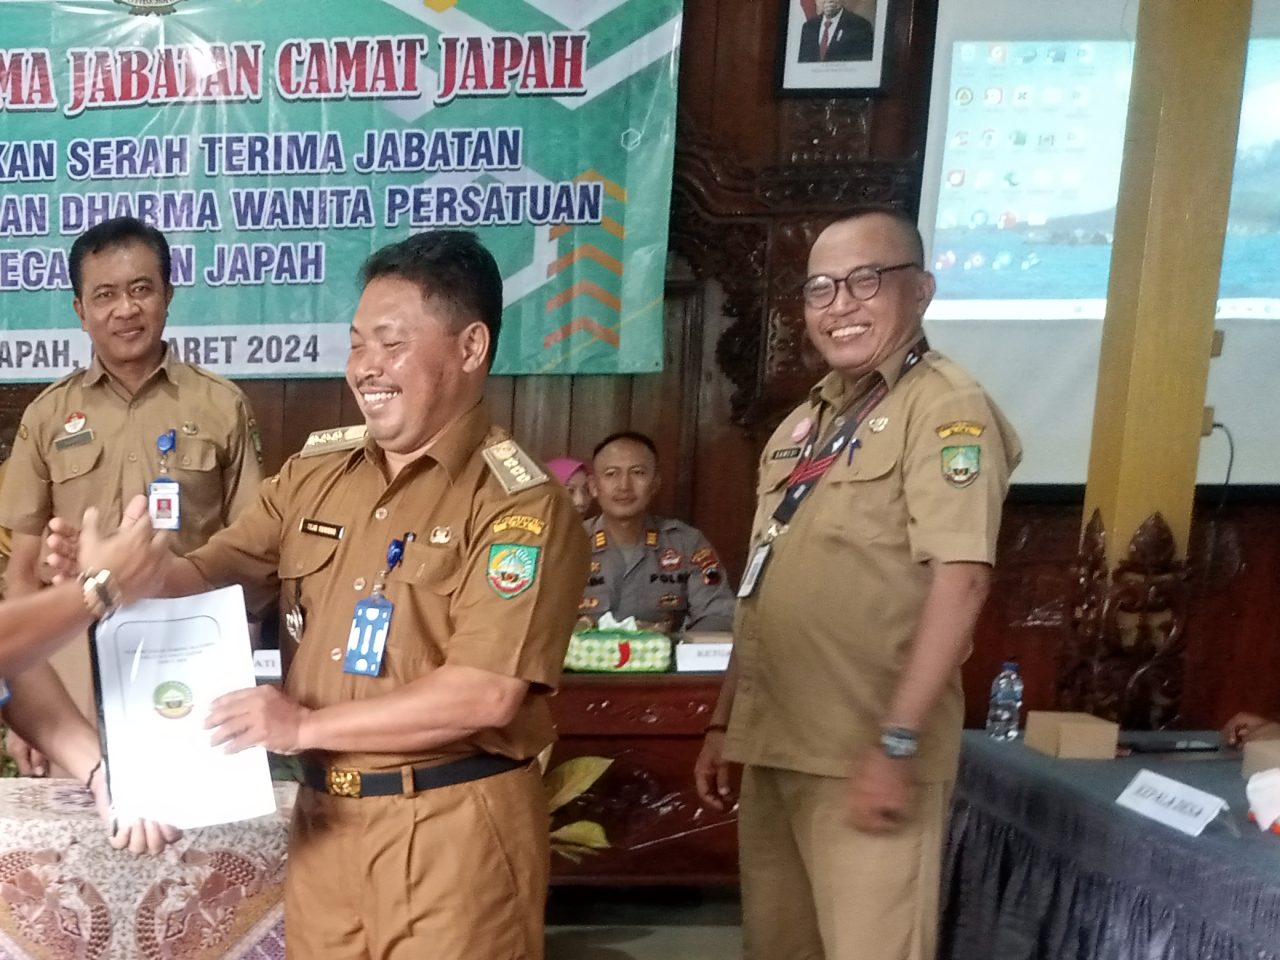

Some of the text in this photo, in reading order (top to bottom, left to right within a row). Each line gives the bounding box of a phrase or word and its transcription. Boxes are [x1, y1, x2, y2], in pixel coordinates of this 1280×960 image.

[66, 44, 263, 113] JABATAN
[277, 36, 426, 97] CAMAT
[437, 33, 587, 101] JAPAH
[69, 136, 187, 178] SERAH
[202, 133, 343, 174] TERIMA
[357, 129, 521, 171] JABATAN
[61, 192, 220, 234] DHARMA
[234, 187, 374, 228] WANITA
[387, 183, 601, 225] PERSATUAN
[207, 243, 324, 284] JAPAH
[168, 336, 237, 364] ARET
[247, 335, 319, 363] 2024
[254, 659, 276, 668] ATI
